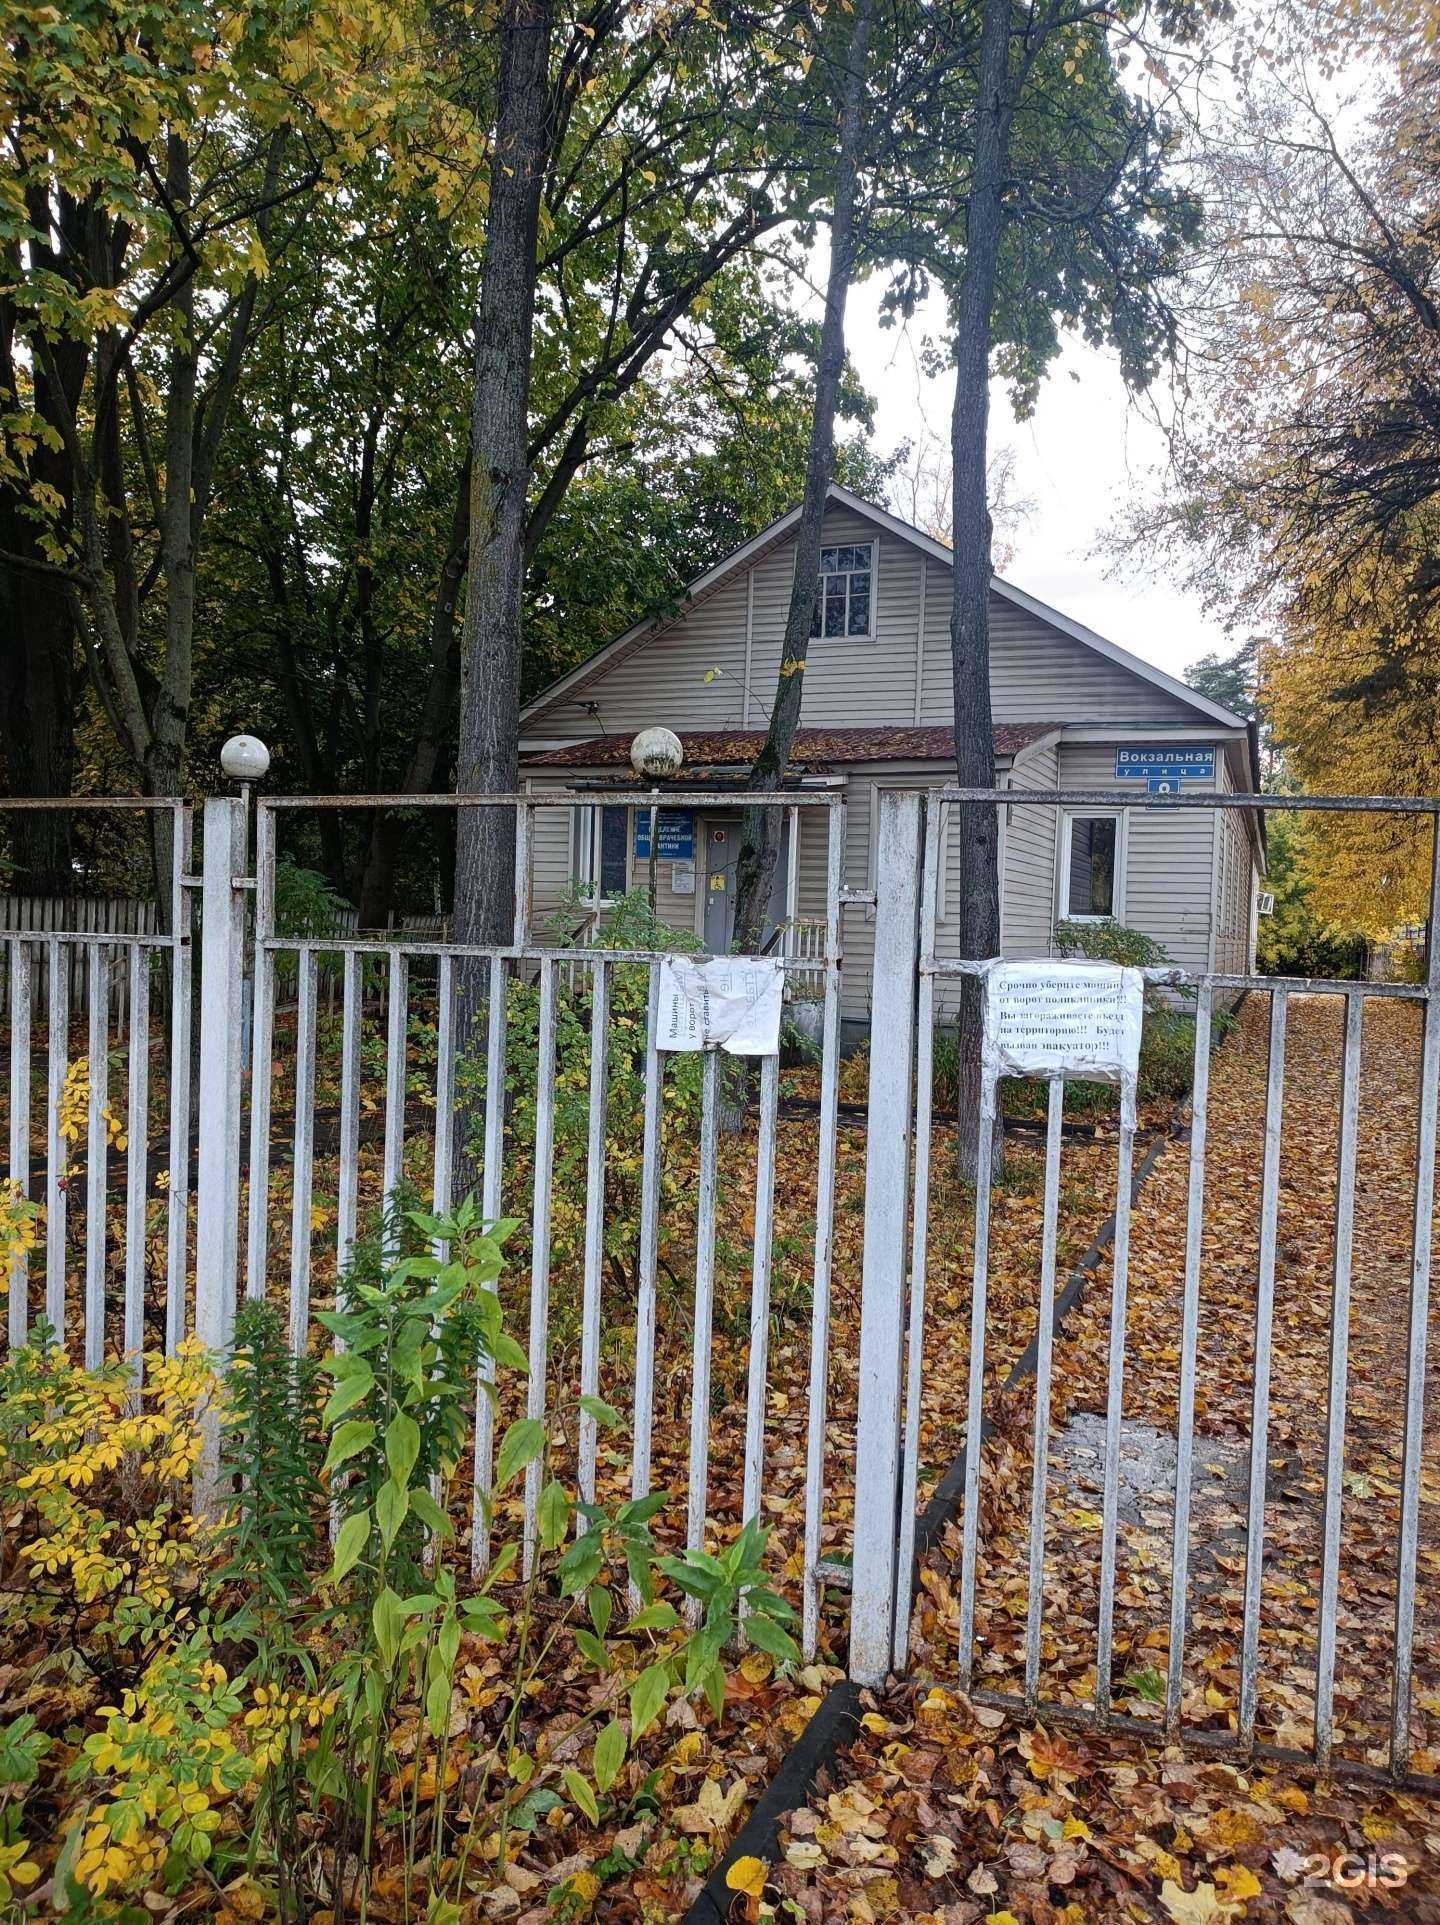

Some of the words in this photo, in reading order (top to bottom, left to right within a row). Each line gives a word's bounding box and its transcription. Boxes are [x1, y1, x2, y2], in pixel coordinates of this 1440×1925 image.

[1120, 751, 1212, 762] Вокзальная
[1000, 981, 1037, 991] Срочно
[1040, 981, 1080, 991] уберите
[669, 994, 679, 1039] Машины
[1000, 1011, 1016, 1019] Вы
